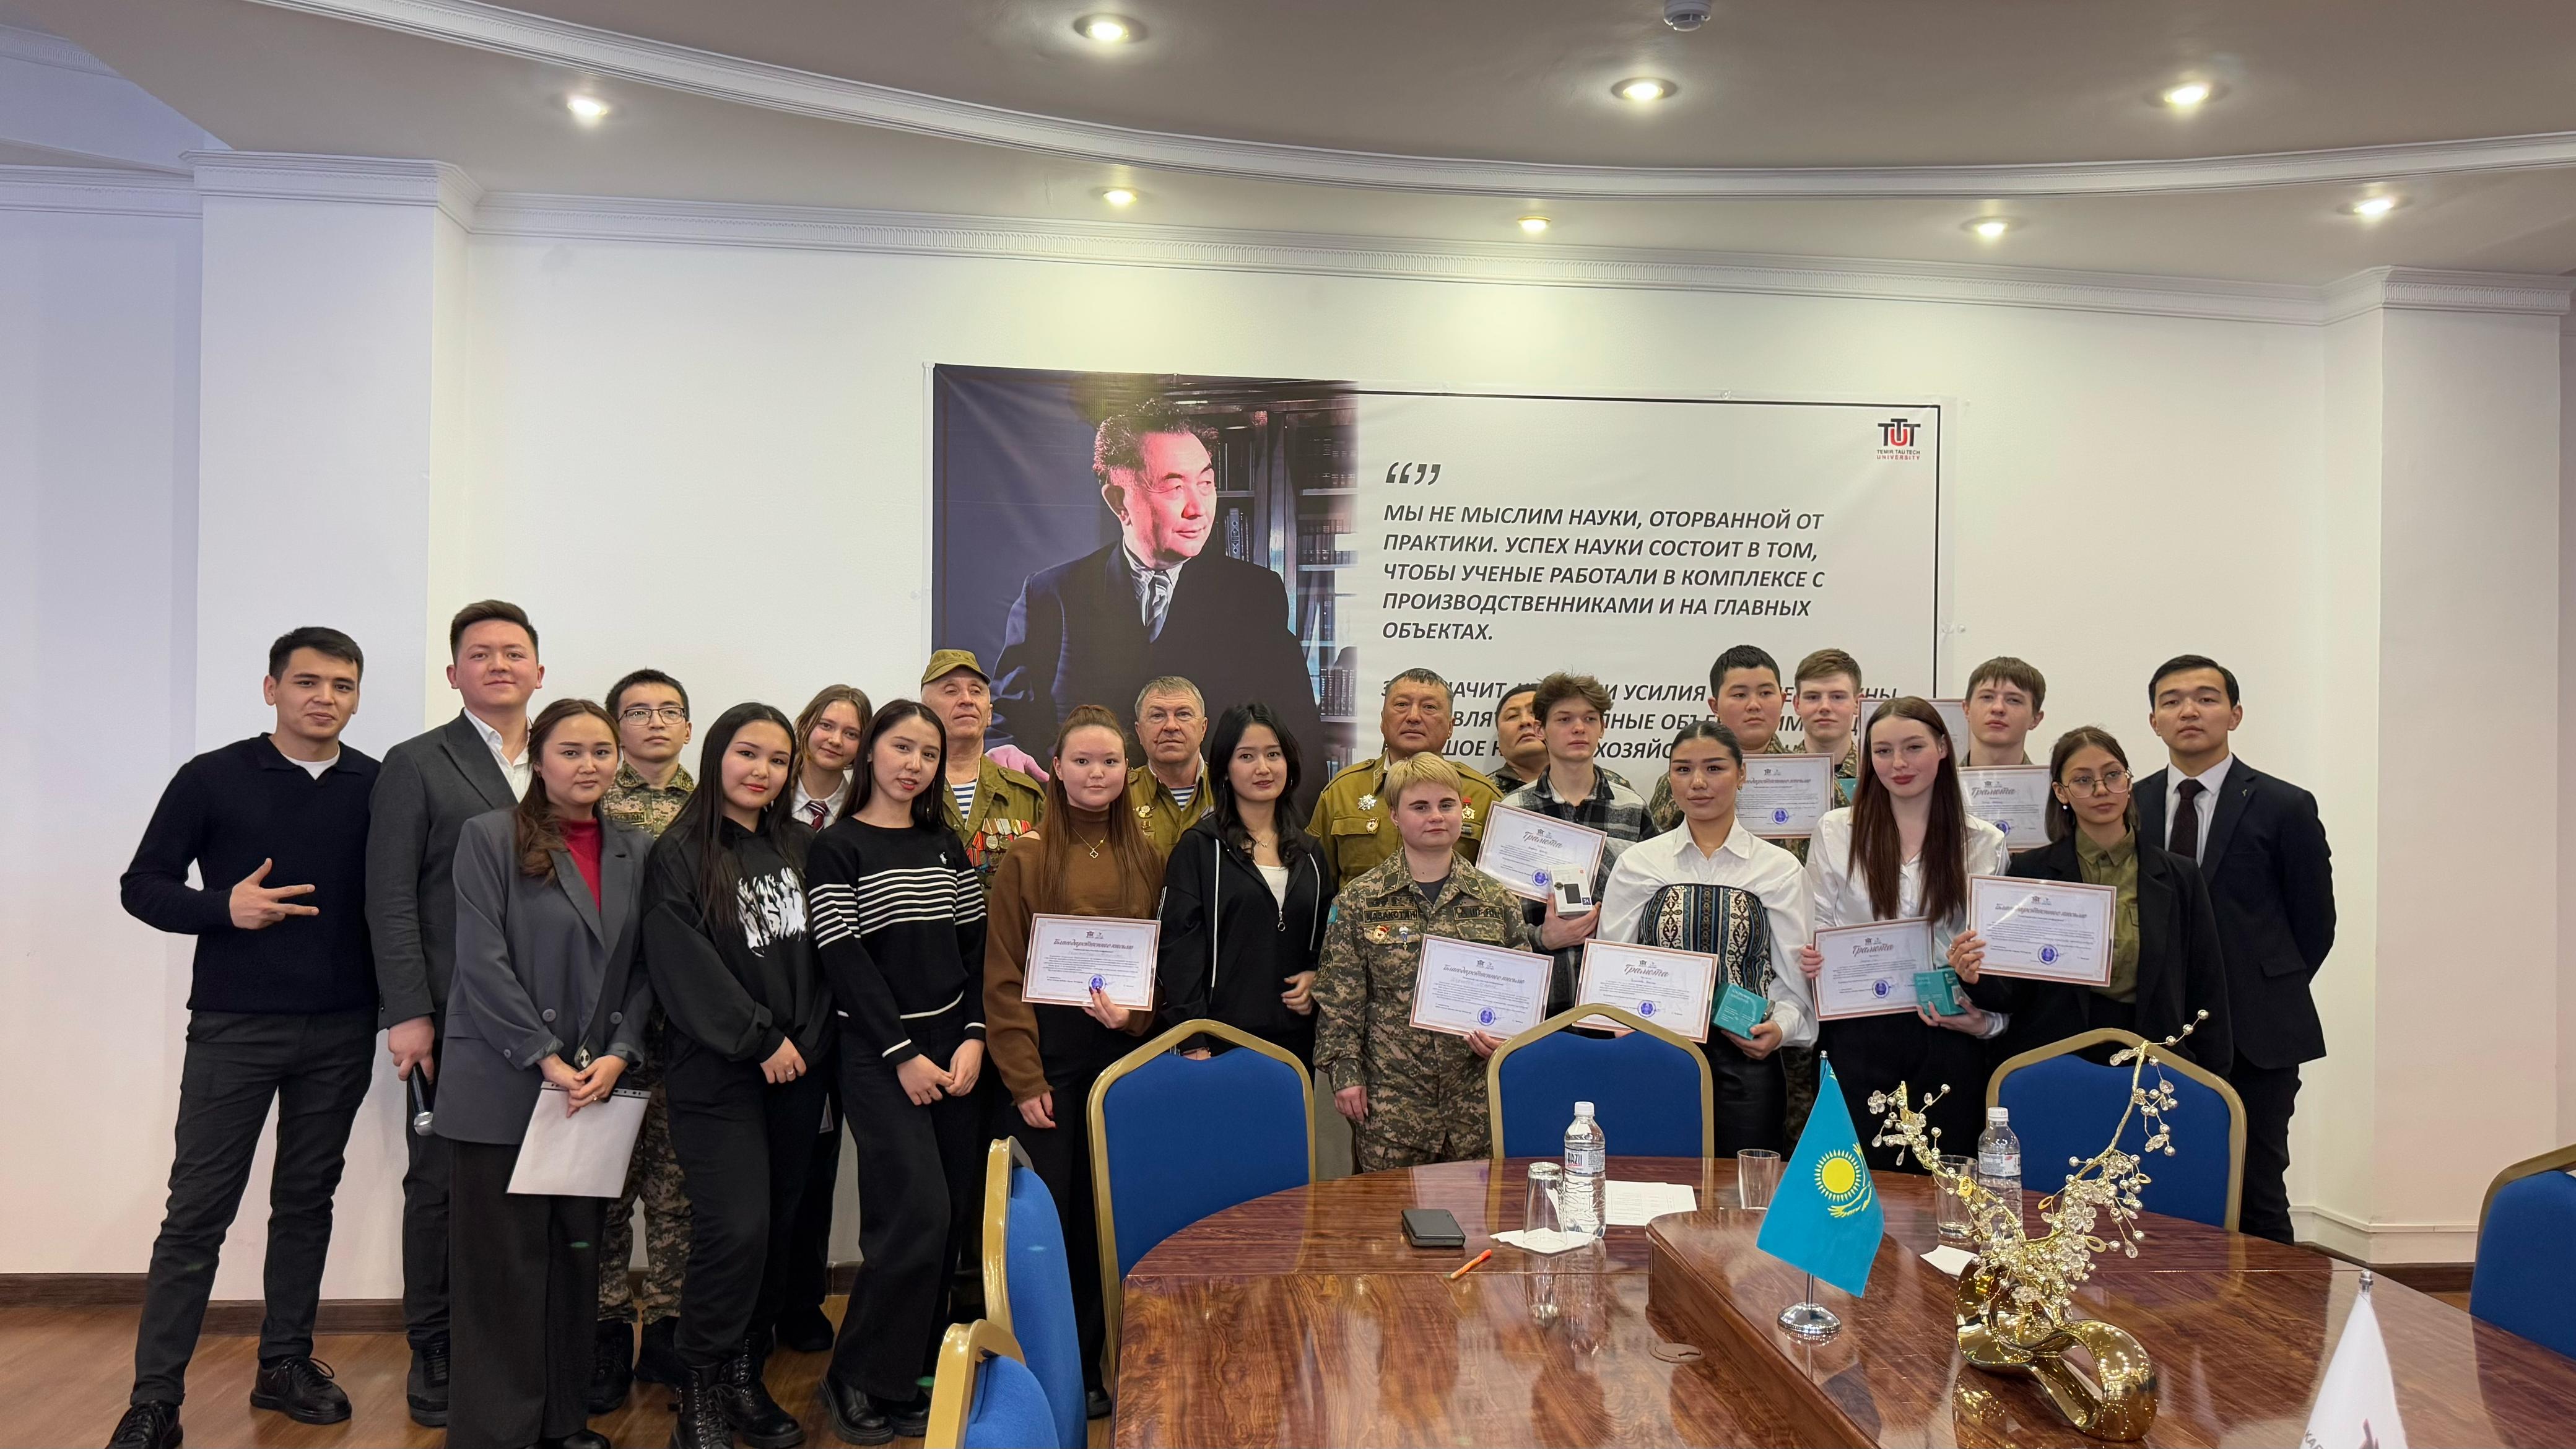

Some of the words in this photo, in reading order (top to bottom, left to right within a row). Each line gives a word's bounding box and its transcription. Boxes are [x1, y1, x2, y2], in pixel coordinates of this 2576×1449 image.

[1383, 505, 1424, 521] МЫ
[1429, 505, 1456, 522] НЕ
[1461, 507, 1564, 524] МЫСЛИМ
[1569, 509, 1642, 530] НАУКИ,
[1650, 508, 1791, 529] ОТОРВАННОЙ
[1796, 513, 1824, 529] ОТ
[1383, 534, 1497, 553] ПРАКТИКИ.
[1505, 537, 1570, 554] УСПЕХ
[1574, 538, 1643, 555] НАУКИ
[1649, 539, 1744, 557] СОСТОИТ
[1747, 541, 1760, 557] В
[1767, 542, 1817, 562] ТОМ,
[1384, 563, 1456, 581] ЧТОБЫ
[1461, 565, 1545, 583] УЧЕНЫЕ
[1549, 567, 1658, 585] РАБОТАЛИ
[1663, 569, 1676, 585] В
[1681, 569, 1808, 588] КОМПЛЕКСЕ
[1812, 572, 1825, 588] С
[1383, 593, 1654, 615] ПРОИЗВОДСТВЕННИКАМИ
[1659, 598, 1674, 614] И
[1679, 598, 1707, 615] НА
[1713, 599, 1812, 617] ГЛАВНЫХ
[1383, 622, 1492, 640] ОБЪЕКТАХ.
[1623, 684, 1707, 702] УСИЛИЯ
[1972, 787, 2016, 798] Грамота
[1523, 831, 1564, 849] Грамота
[1852, 942, 1894, 957] Грамота
[1623, 964, 1669, 978] Грамота
